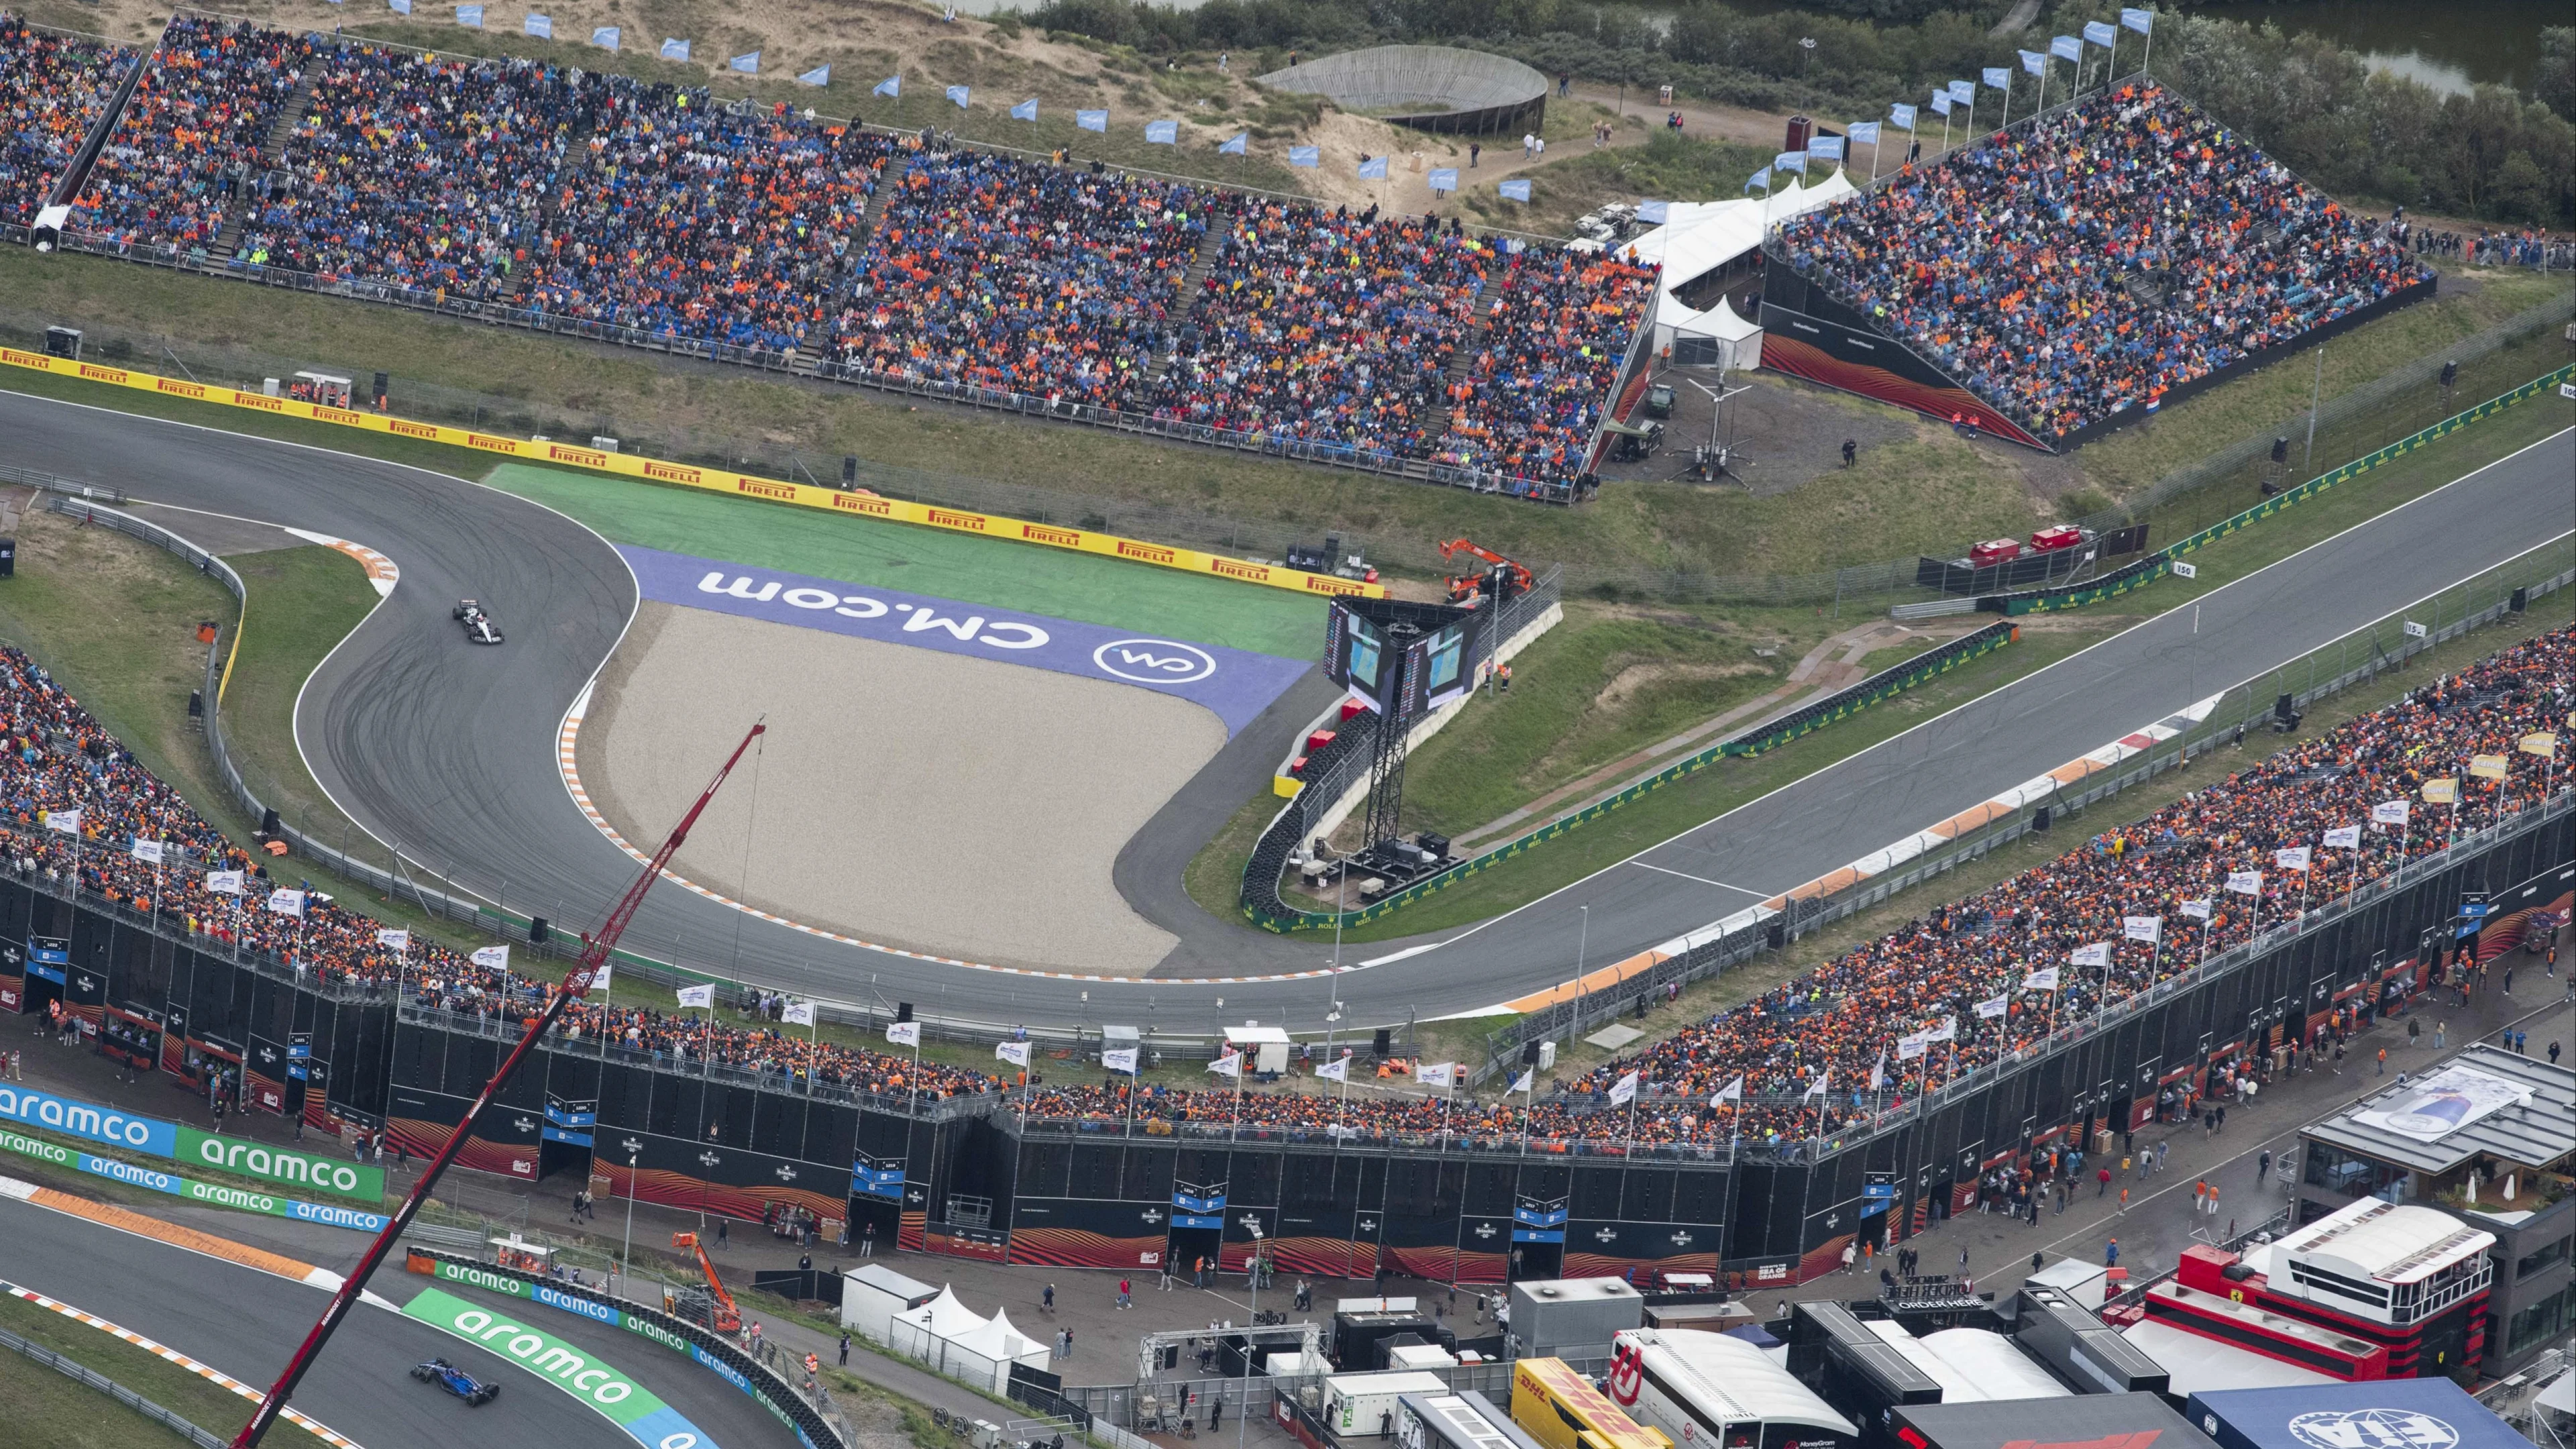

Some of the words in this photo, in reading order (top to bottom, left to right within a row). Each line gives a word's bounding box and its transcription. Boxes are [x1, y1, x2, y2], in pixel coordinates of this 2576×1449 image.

[2, 350, 48, 368] PIRELLI
[80, 365, 127, 383] PIRELLI
[158, 380, 204, 397] PIRELLI
[235, 393, 281, 411] PIRELLI
[313, 407, 359, 425] PIRELLI
[390, 421, 436, 438] PIRELLI
[468, 435, 515, 452] PIRELLI
[550, 446, 606, 467] PIRELLI
[645, 463, 700, 483] PIRELLI
[739, 479, 795, 499] PIRELLI
[834, 494, 890, 515] PIRELLI
[928, 510, 985, 530] PIRELLI
[1022, 525, 1079, 546] PIRELLI
[1118, 542, 1174, 562] PIRELLI
[1212, 559, 1269, 580] PIRELLI
[2177, 564, 2191, 575] 150
[1307, 576, 1364, 596] PIRELLI
[697, 572, 1050, 649] CM.com
[1355, 916, 1371, 926] ROLEX
[1379, 907, 1393, 917] ROLEX
[1291, 923, 1310, 931] ROLEX
[125, 1009, 144, 1020] DRINKS
[205, 1040, 224, 1051] DRINKS
[468, 1097, 485, 1120] MAMMOET
[0, 1131, 66, 1162] ramco
[91, 1158, 168, 1189] aramco
[201, 1138, 358, 1191] aramco
[193, 1184, 273, 1211] aramco
[297, 1203, 378, 1228] aramco
[394, 1199, 413, 1223] MAMMOET
[446, 1265, 519, 1293] aramco
[1758, 1273, 1786, 1281] ORANGE
[321, 1299, 341, 1326] MAMMOET
[540, 1288, 608, 1320] aramco
[1898, 1301, 1946, 1309] ORDER
[1945, 1299, 1984, 1307] HERE
[627, 1316, 684, 1350] aramco
[453, 1310, 632, 1403] aramco
[699, 1350, 745, 1387] aramco
[1519, 1374, 1546, 1403] DHL
[251, 1400, 271, 1430] MAMMOET
[757, 1389, 792, 1429] aramco
[1800, 1440, 1835, 1448] MoneyGram
